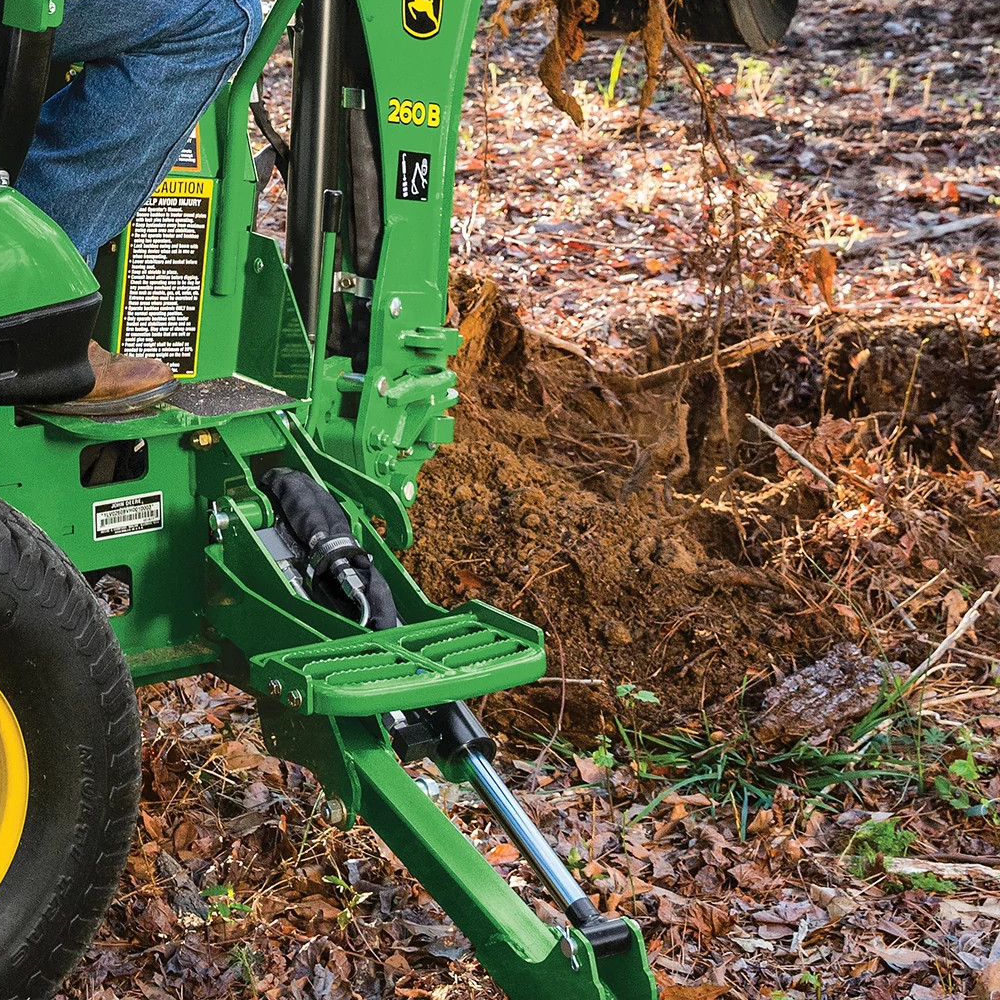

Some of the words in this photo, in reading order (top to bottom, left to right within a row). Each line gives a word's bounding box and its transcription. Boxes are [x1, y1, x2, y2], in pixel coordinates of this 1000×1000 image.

[144, 198, 158, 206] ELP
[158, 198, 178, 206] AVOID
[178, 198, 202, 207] INJURY
